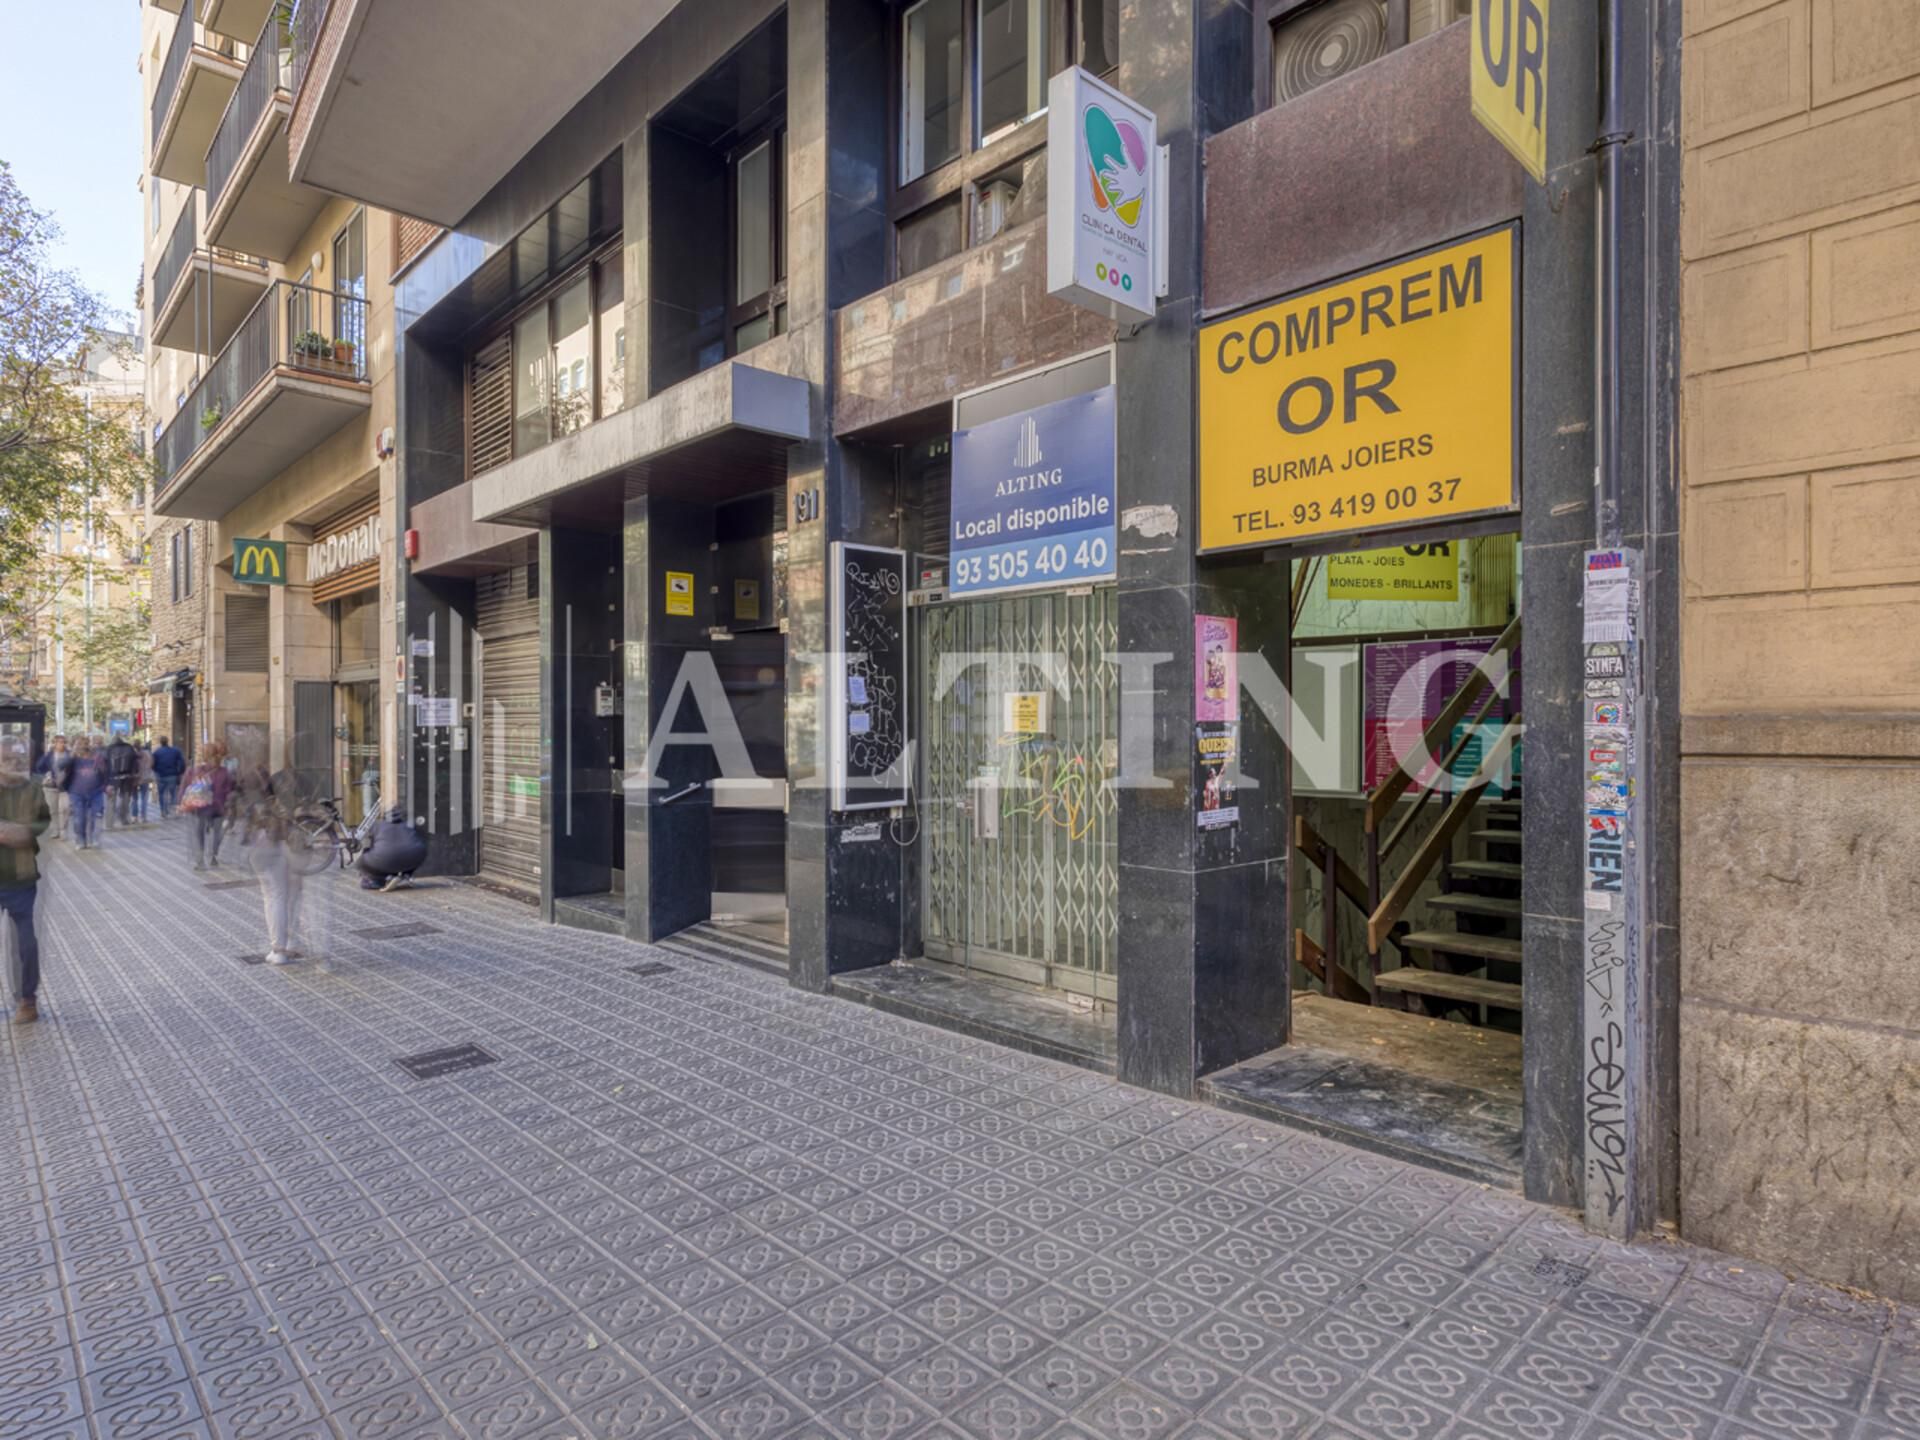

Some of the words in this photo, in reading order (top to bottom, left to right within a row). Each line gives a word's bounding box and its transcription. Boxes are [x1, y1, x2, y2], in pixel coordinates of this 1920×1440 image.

[1217, 254, 1483, 374] COMPREM
[1277, 358, 1401, 435] OR
[994, 468, 1063, 498] ALTING
[1252, 454, 1334, 488] BURMA
[1341, 434, 1434, 470] JOIERS
[955, 512, 1002, 540] Local
[1006, 494, 1110, 530] disponible
[1233, 509, 1285, 534] TEL.
[1292, 501, 1322, 525] 93
[1330, 493, 1375, 518] 419
[1385, 485, 1417, 511] 00
[1427, 477, 1462, 505] 37
[956, 556, 982, 586] 93
[987, 549, 1029, 582] 505
[1035, 543, 1067, 575] 40
[1073, 537, 1108, 569] 40
[1329, 555, 1364, 566] PLATA
[1373, 556, 1405, 567] JOIES
[1329, 578, 1384, 589] MONEDES
[1393, 579, 1453, 591] BRILLANTS
